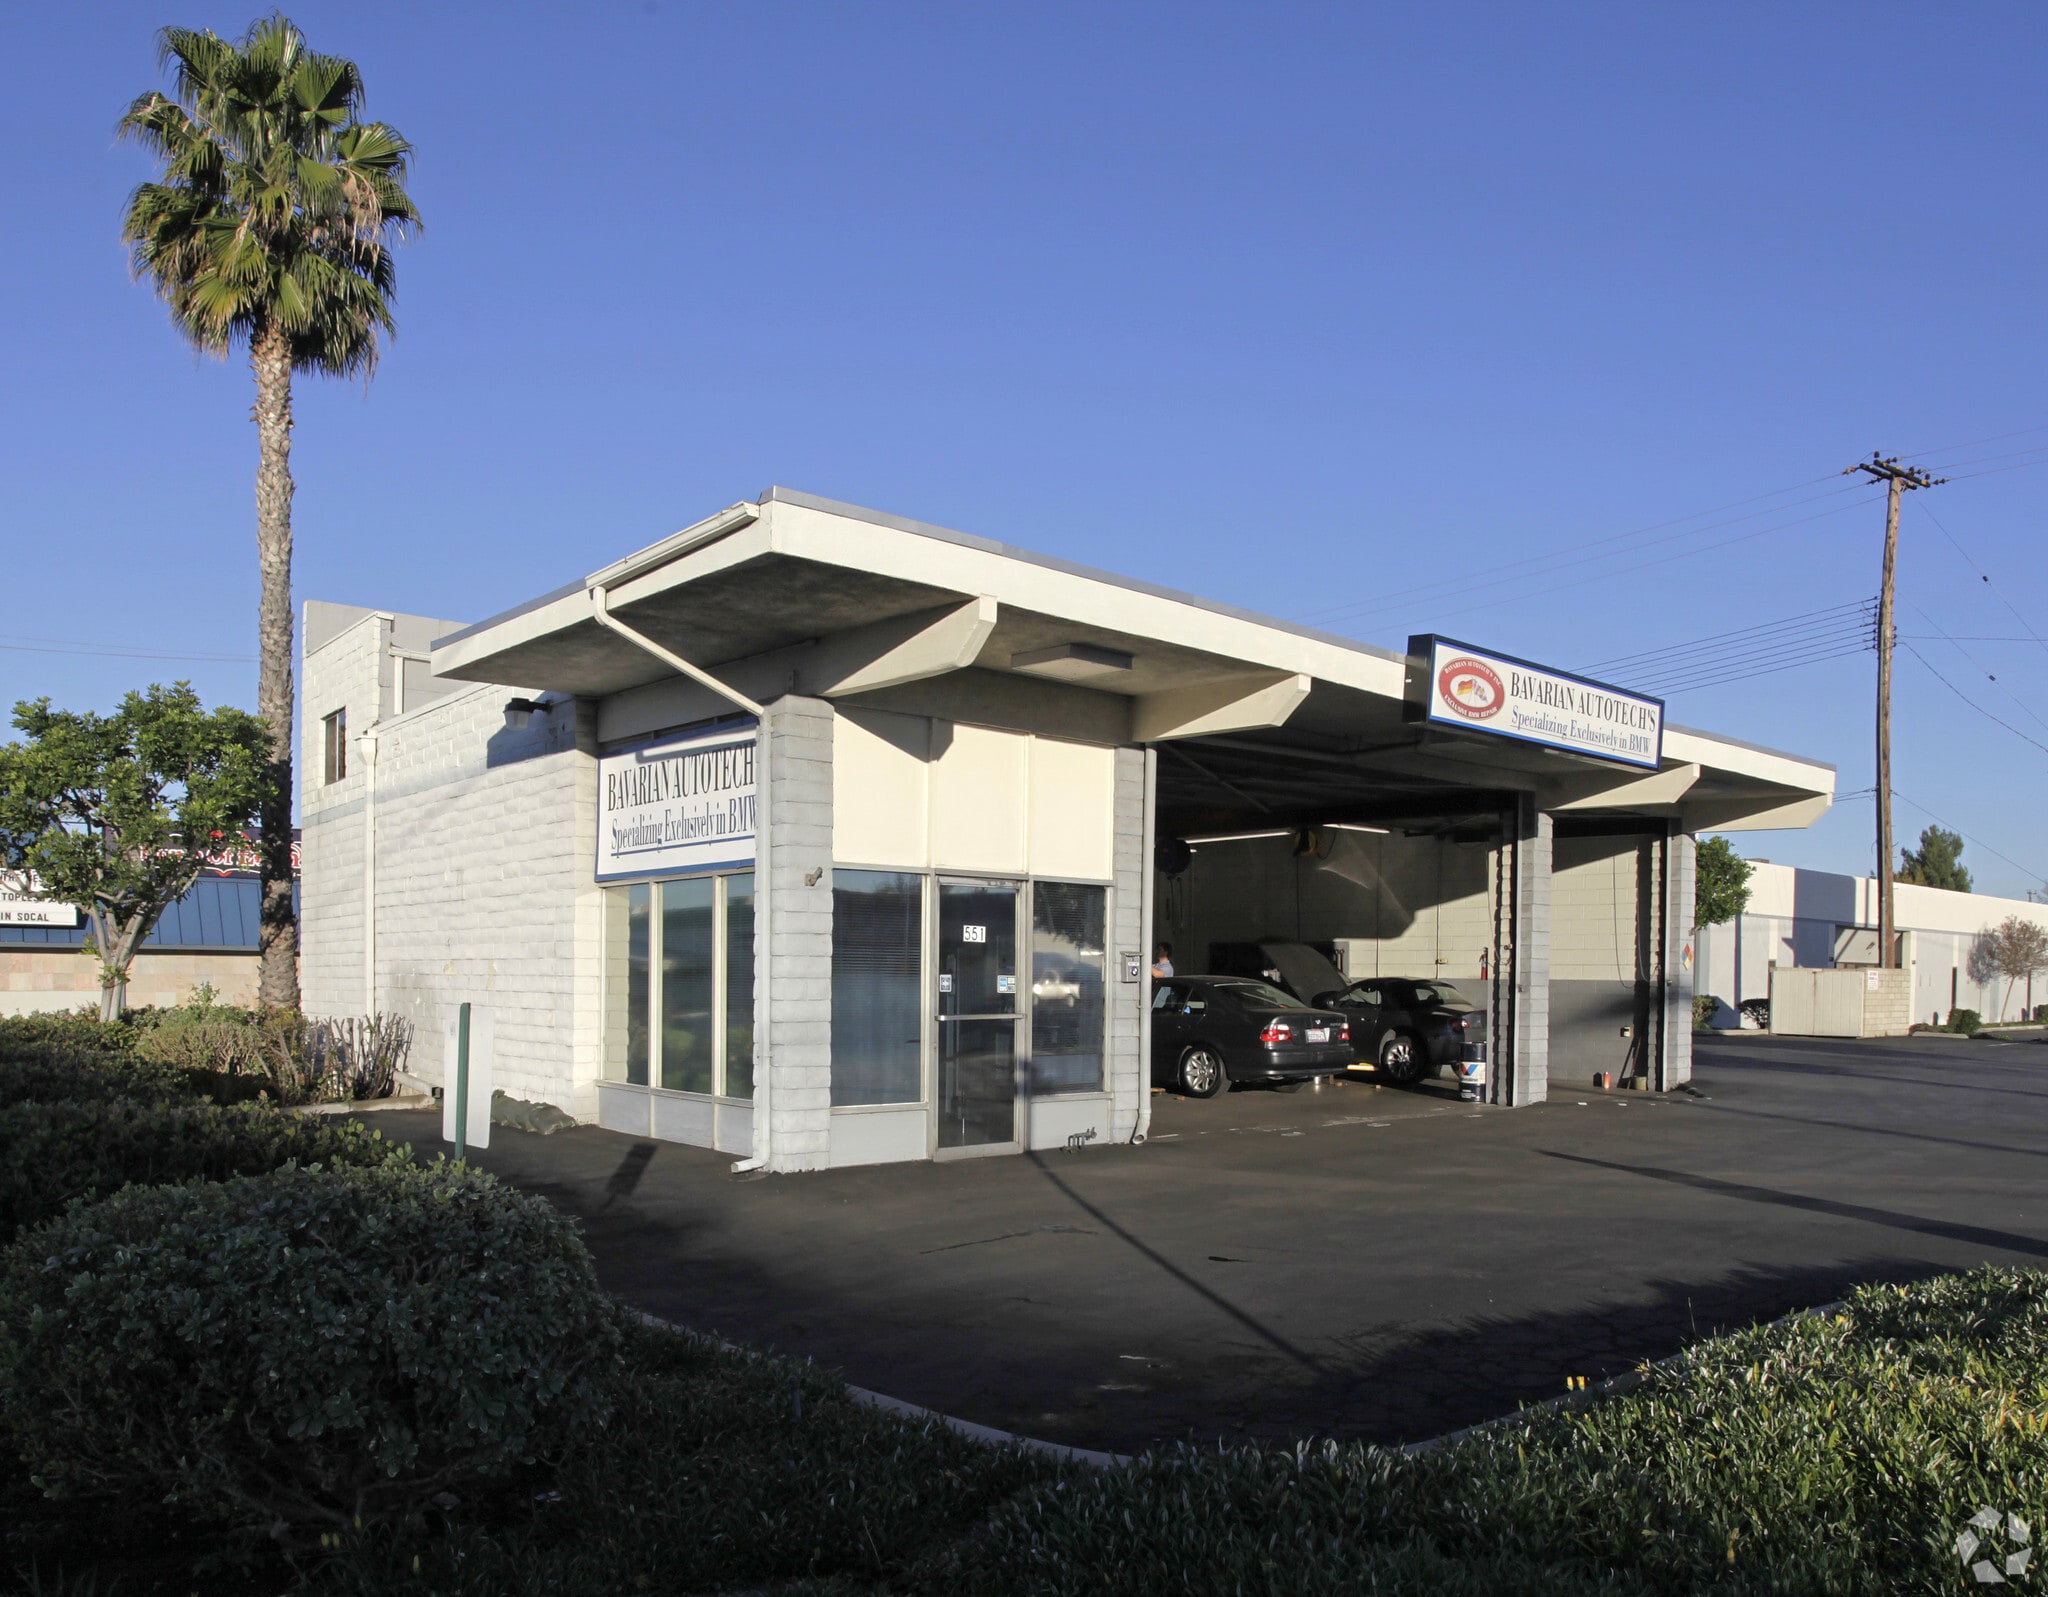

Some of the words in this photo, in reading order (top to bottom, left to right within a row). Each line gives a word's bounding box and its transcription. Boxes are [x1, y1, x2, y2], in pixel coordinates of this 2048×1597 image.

[1510, 672, 1574, 711] BAVARIAN
[1577, 692, 1656, 732] AUTOTECH'S
[1511, 705, 1568, 741] Specializing
[1570, 719, 1618, 751] Exclusively
[1619, 732, 1627, 750] in
[1629, 734, 1652, 753] BMW
[608, 760, 670, 811] BAVARIAN
[672, 745, 755, 799] AUTOTECH
[611, 808, 663, 858] Specializing
[664, 802, 715, 846] Exclusively
[716, 802, 726, 835] in
[17, 912, 49, 921] SOCAL
[964, 926, 984, 942] 551
